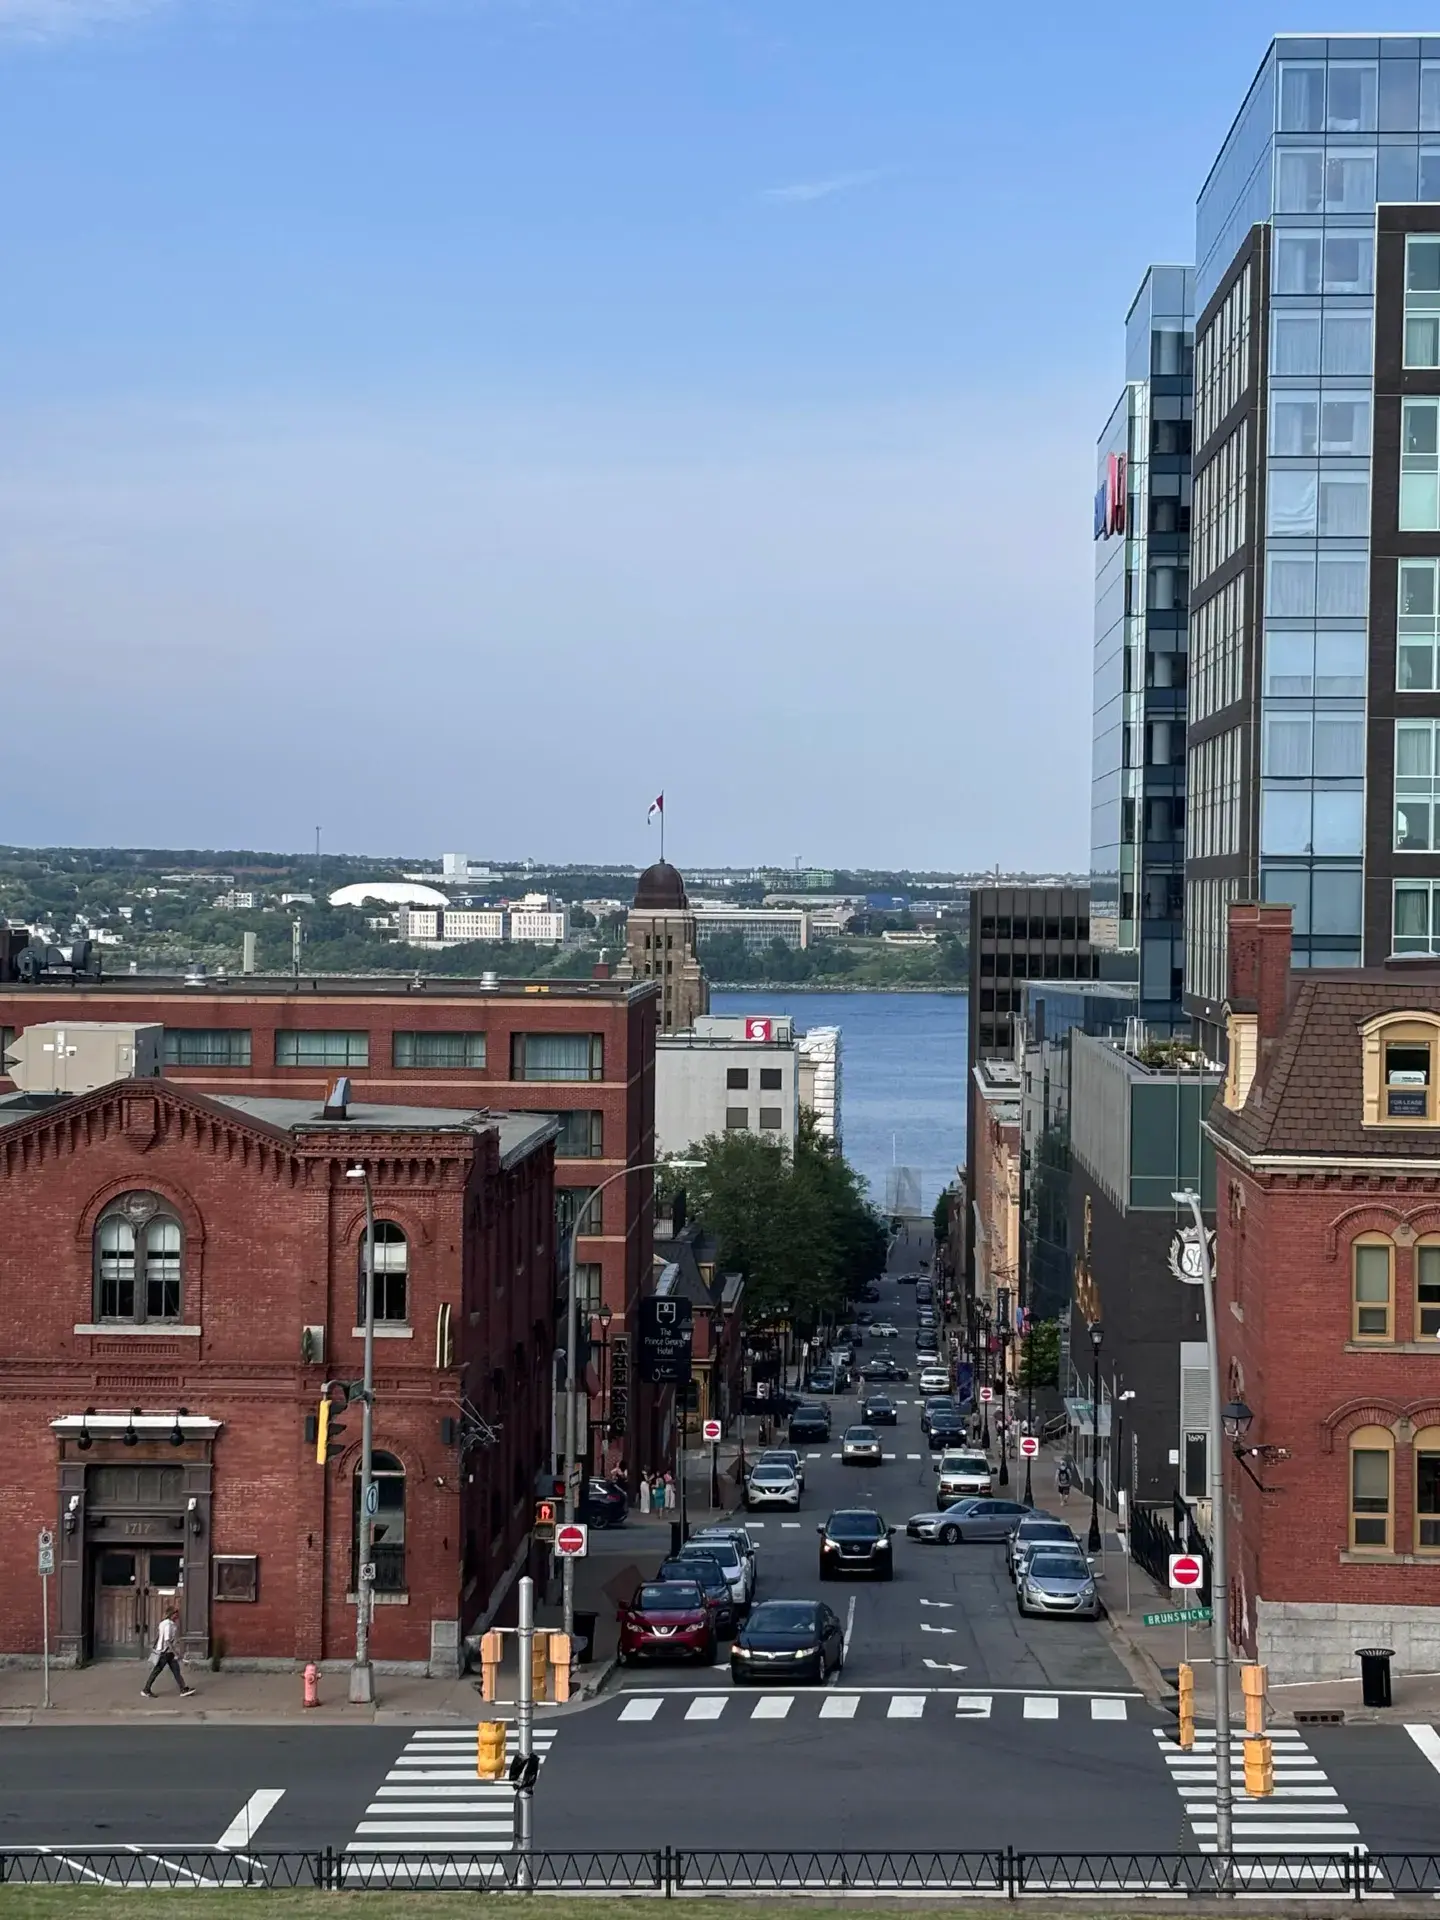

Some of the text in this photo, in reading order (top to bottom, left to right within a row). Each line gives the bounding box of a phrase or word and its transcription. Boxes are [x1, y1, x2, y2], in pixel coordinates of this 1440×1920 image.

[660, 1327, 672, 1336] The
[644, 1337, 664, 1346] Prince
[656, 1346, 674, 1355] Hotel
[1187, 1433, 1205, 1442] 1699
[124, 1522, 151, 1535] 1717
[1147, 1609, 1204, 1625] BRUNSWICK
